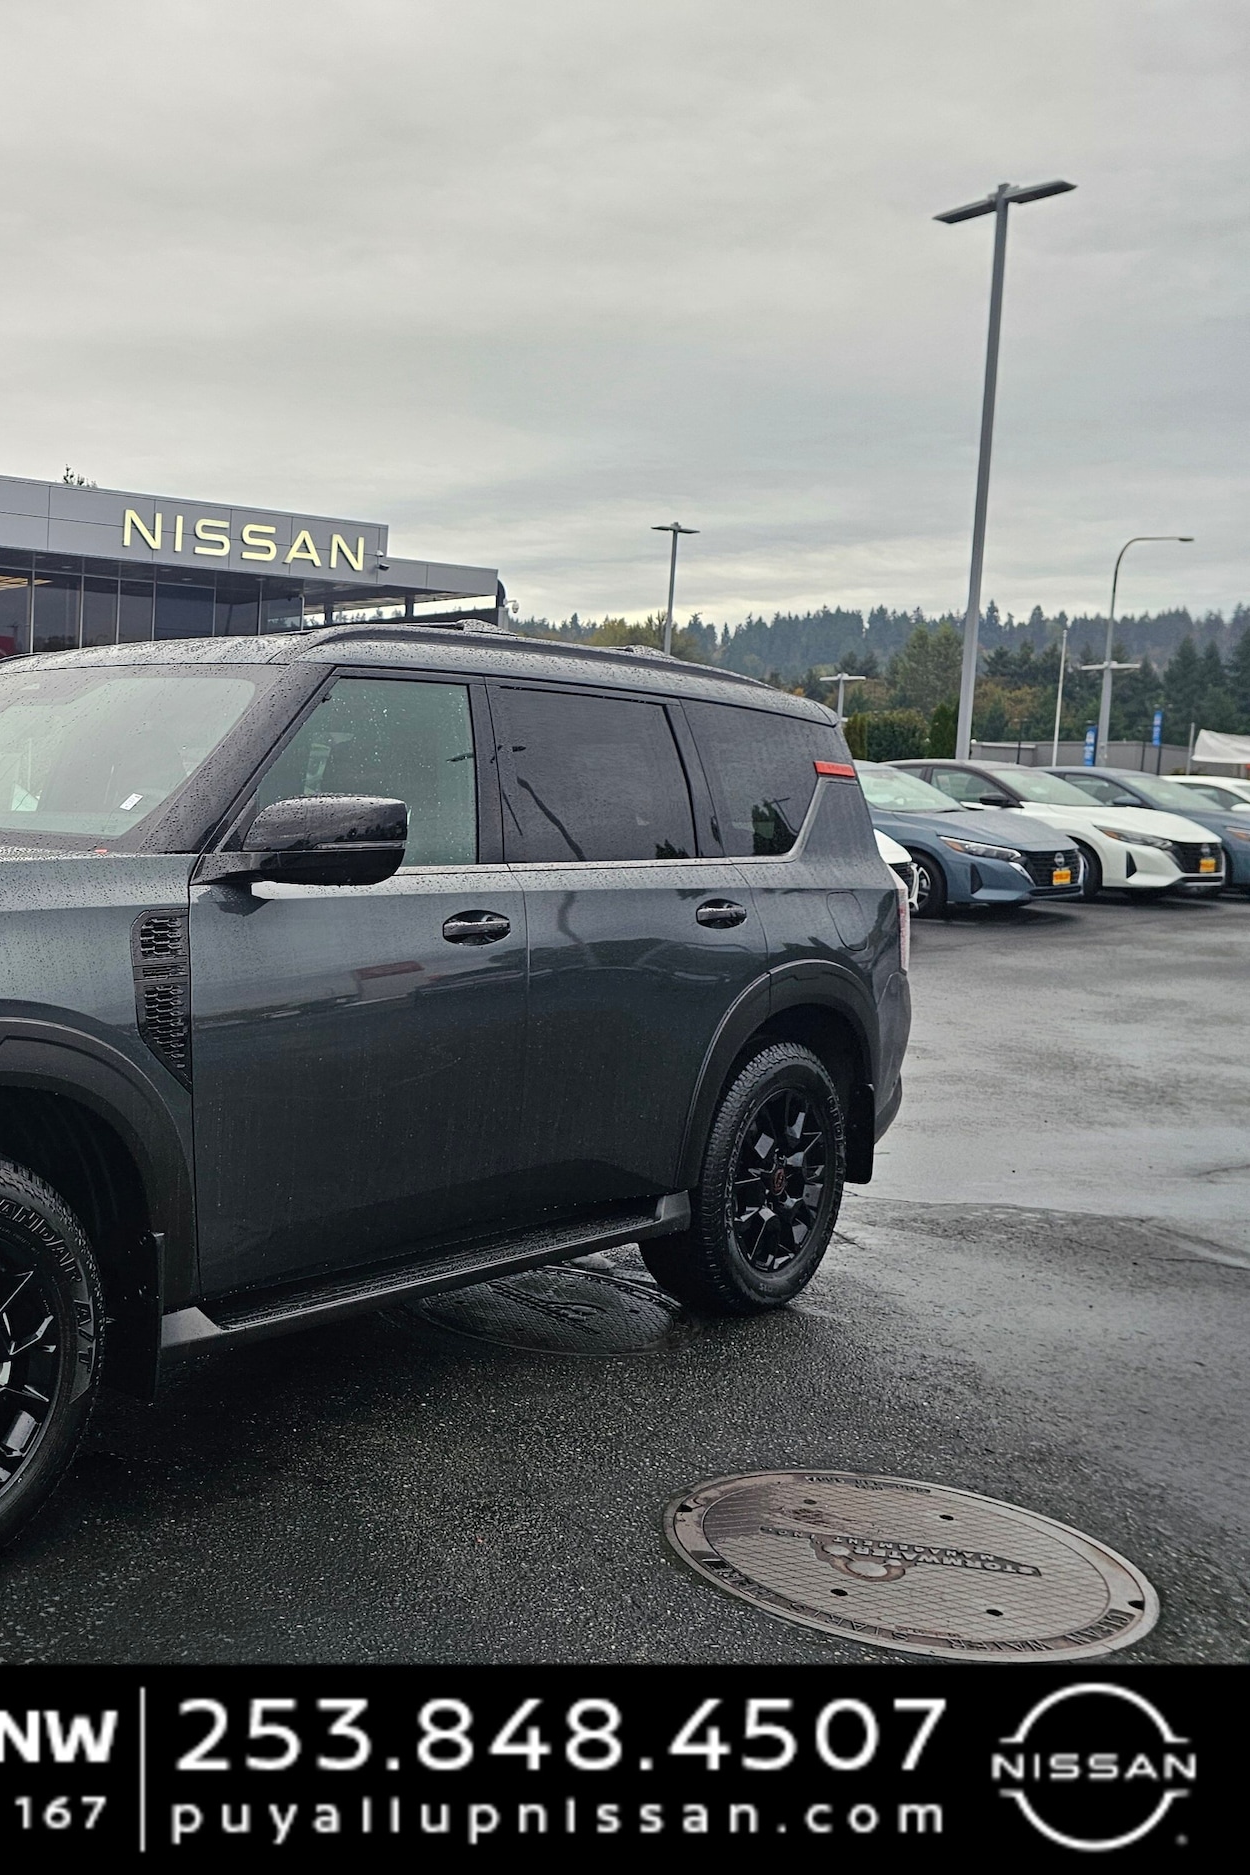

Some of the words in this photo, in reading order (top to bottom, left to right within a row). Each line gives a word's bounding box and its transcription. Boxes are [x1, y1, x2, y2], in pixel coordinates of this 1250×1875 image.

[123, 509, 365, 571] NISSAN
[833, 1536, 996, 1562] MANAGEMENT
[853, 1546, 1038, 1575] STORMWATER
[1063, 1612, 1130, 1646] CLEAN
